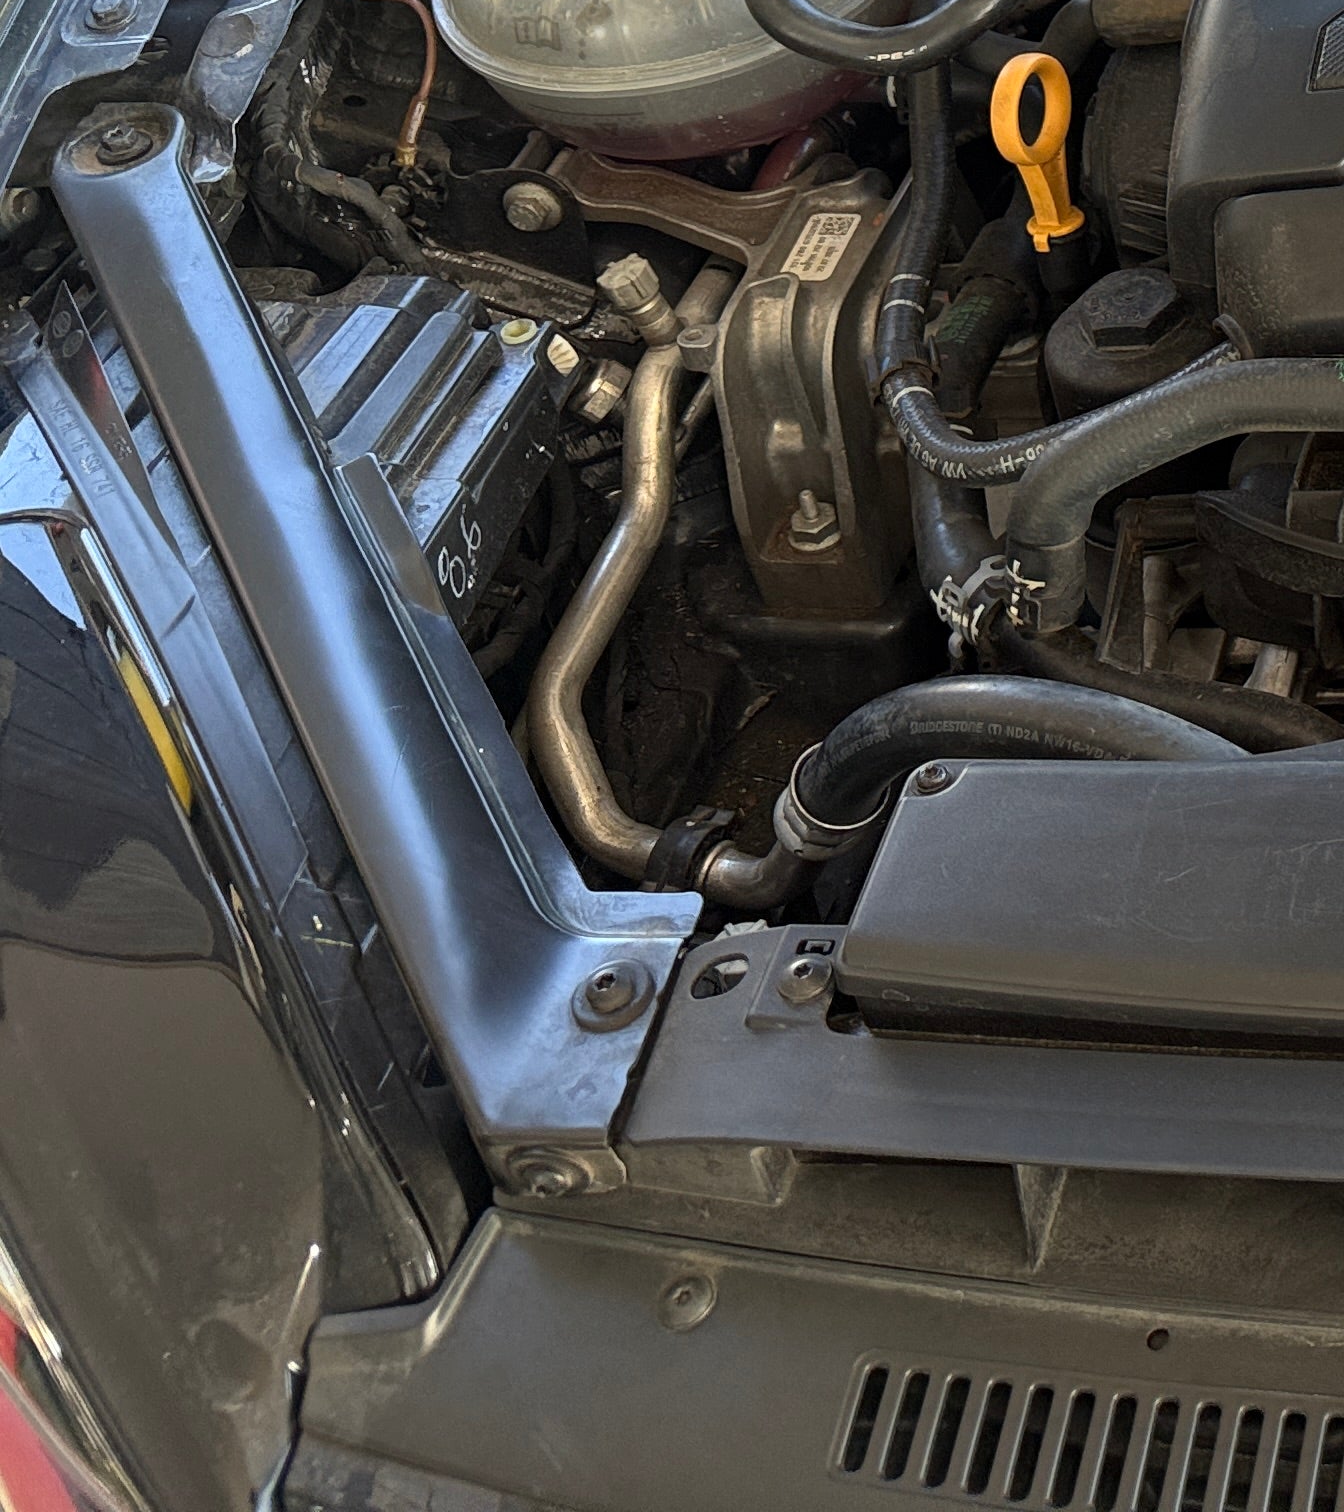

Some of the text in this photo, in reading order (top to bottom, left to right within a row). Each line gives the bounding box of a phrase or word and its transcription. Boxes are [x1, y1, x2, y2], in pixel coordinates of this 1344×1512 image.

[941, 460, 967, 479] VW
[910, 720, 984, 736] BRIDGESTONE
[1006, 727, 1039, 744] ND2A
